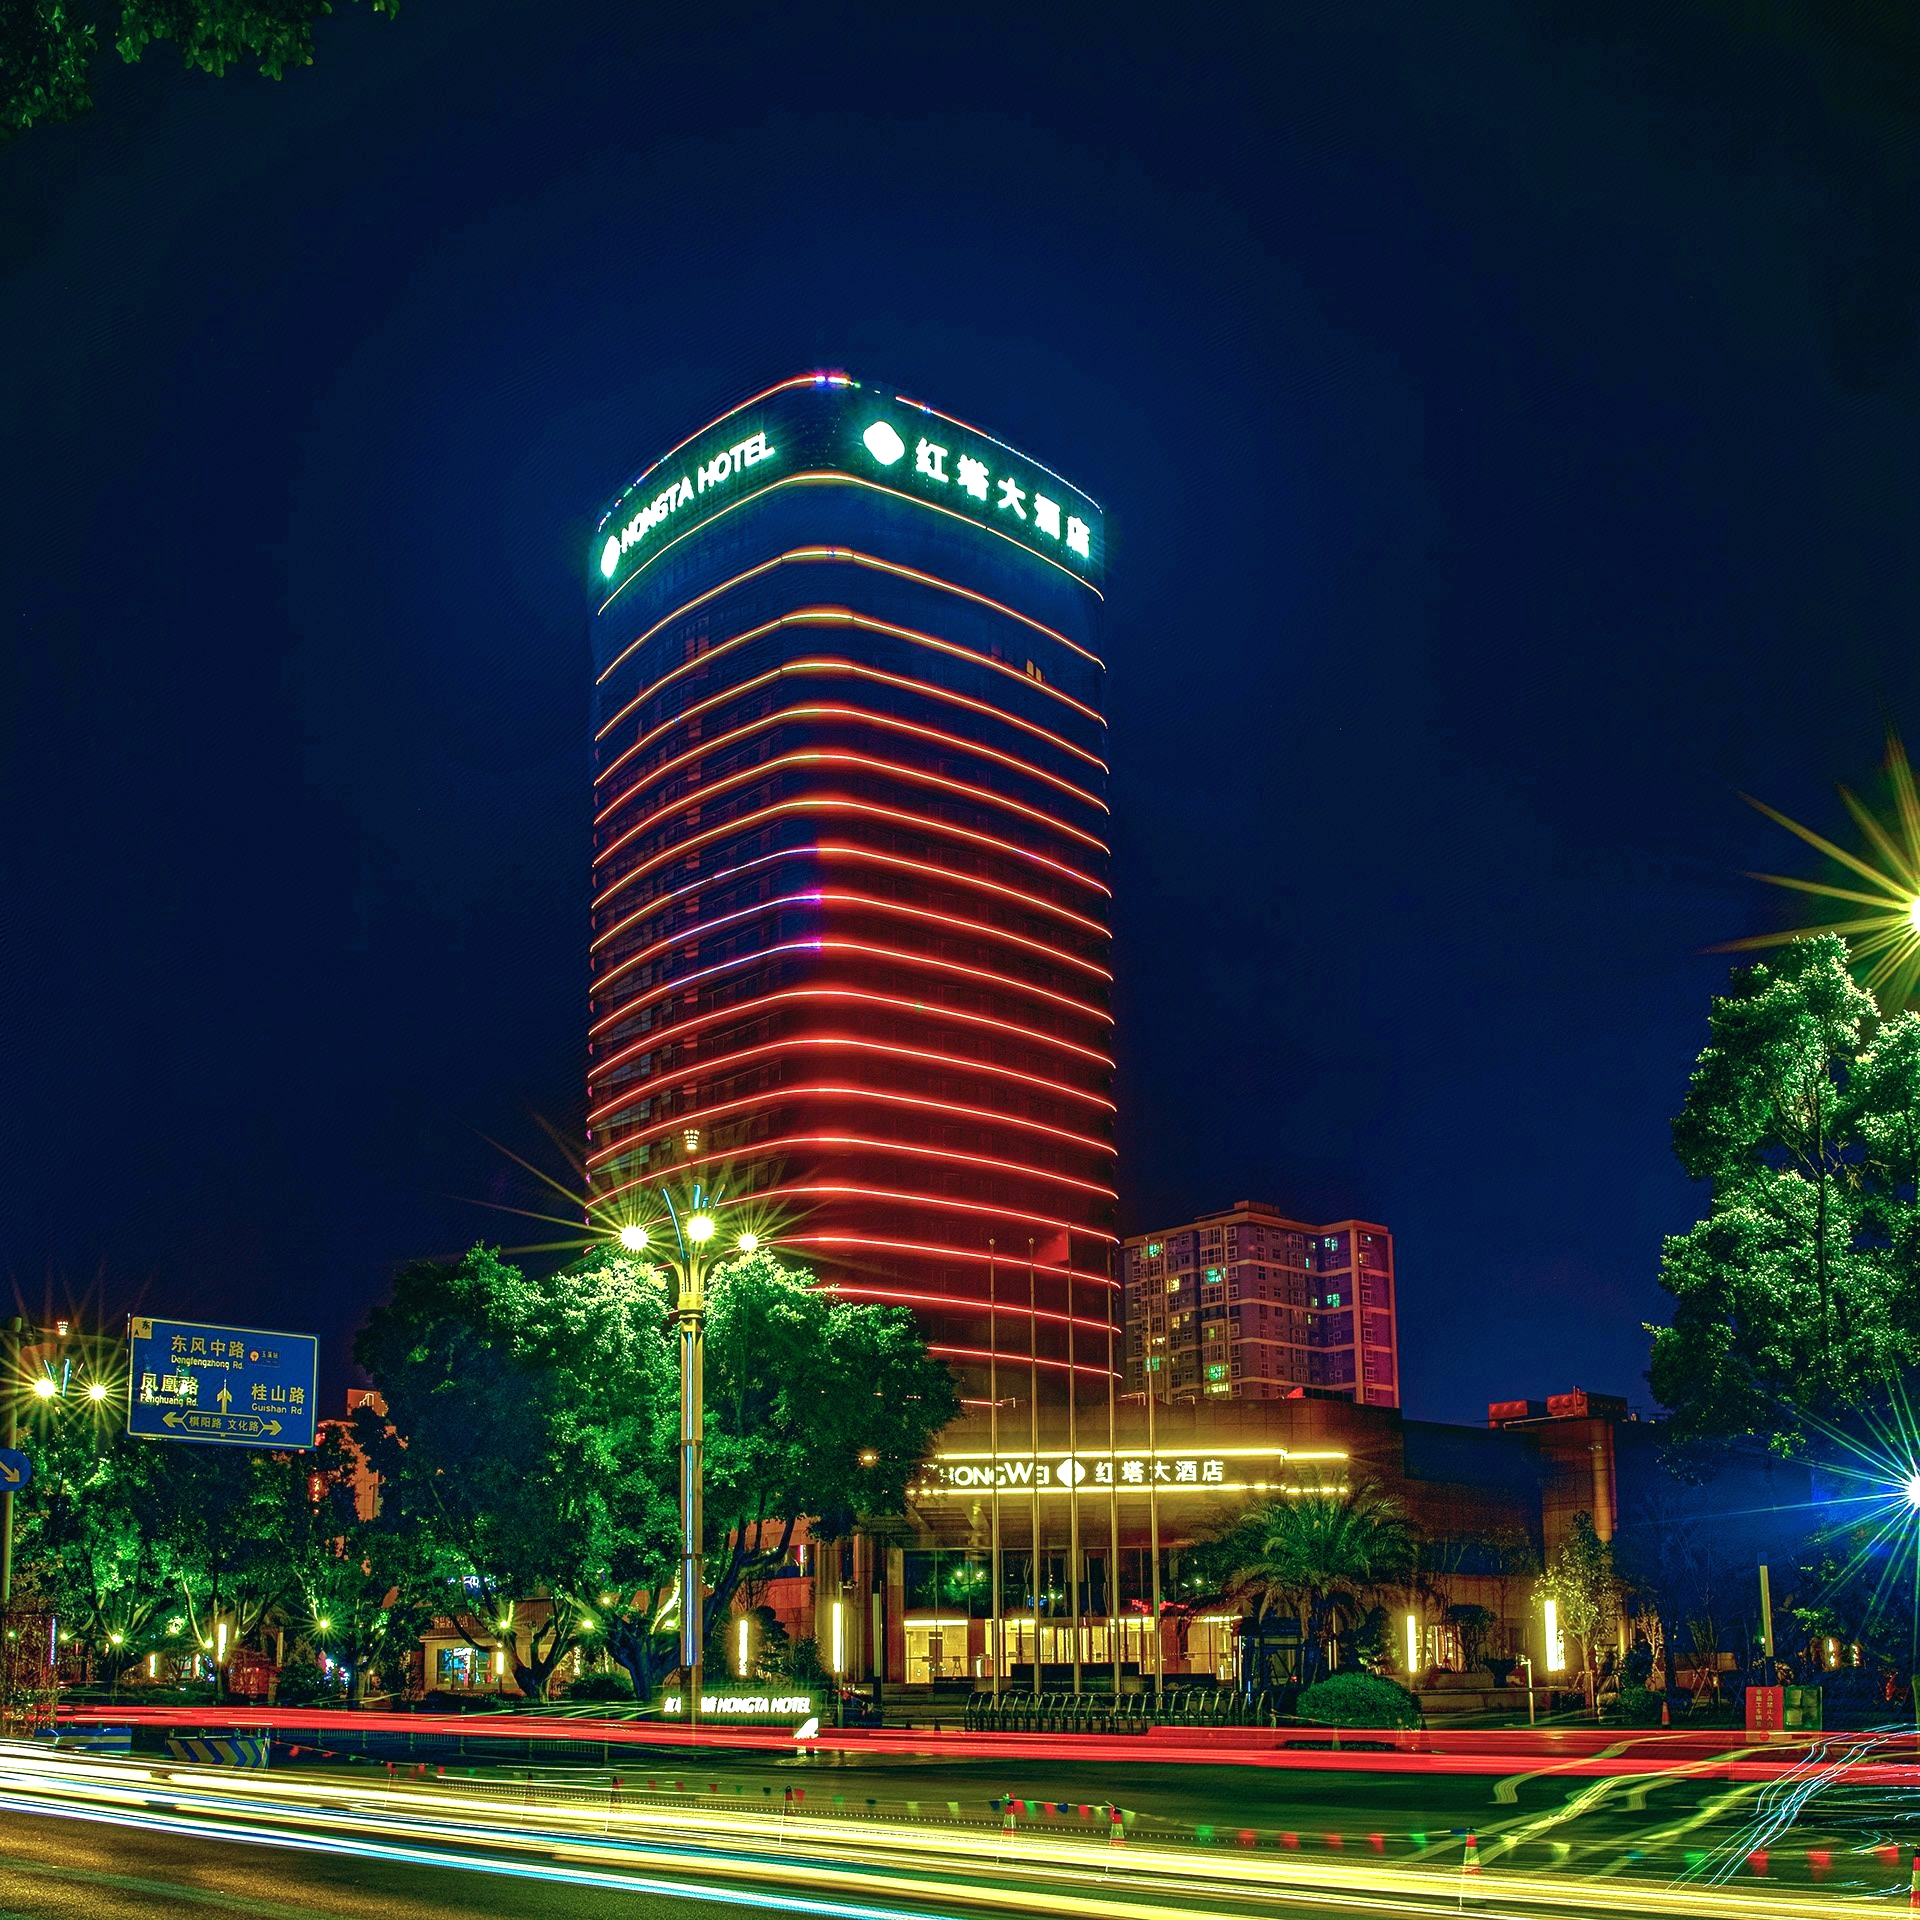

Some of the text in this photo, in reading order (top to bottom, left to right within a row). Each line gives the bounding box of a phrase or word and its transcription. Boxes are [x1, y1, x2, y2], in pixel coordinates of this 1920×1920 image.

[621, 432, 776, 554] HONGTA HOTEL
[915, 437, 1091, 559] 红塔大酒店
[170, 1334, 245, 1359] 东风中路
[171, 1355, 230, 1371] Dongfengzhong
[140, 1372, 199, 1396] 凤凰路
[251, 1383, 305, 1405] 桂山路
[139, 1392, 199, 1407] Fenghuang Rd.
[251, 1403, 305, 1416] Guishan Rd.
[189, 1416, 259, 1432] 棋阳路 文化路
[1095, 1459, 1225, 1484] 红塔大酒店
[716, 1696, 769, 1714] HONGTA
[771, 1696, 811, 1713] HOTEL
